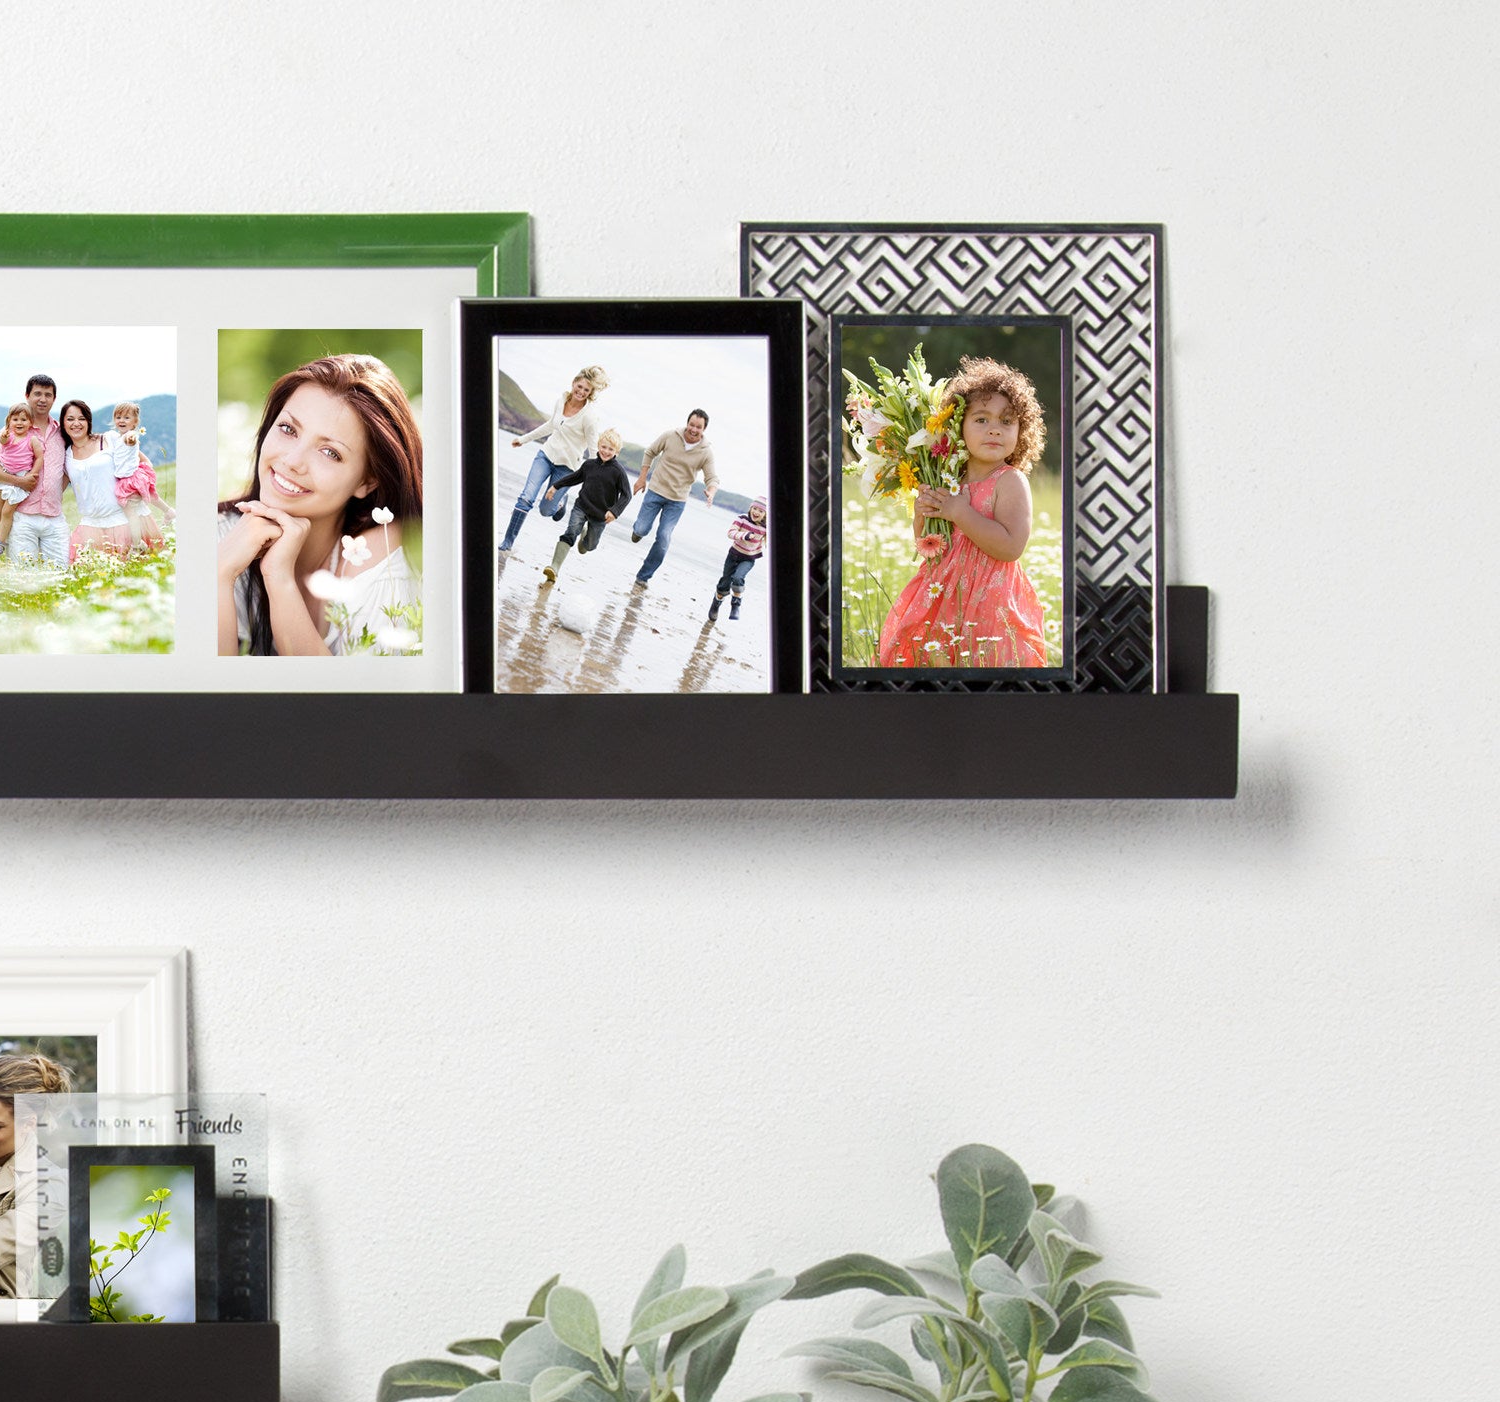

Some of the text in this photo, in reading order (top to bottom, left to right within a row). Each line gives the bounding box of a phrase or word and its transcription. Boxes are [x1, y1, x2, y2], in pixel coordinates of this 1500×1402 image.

[72, 1118, 155, 1129] LEAN ON ME
[175, 1109, 243, 1135] Friends
